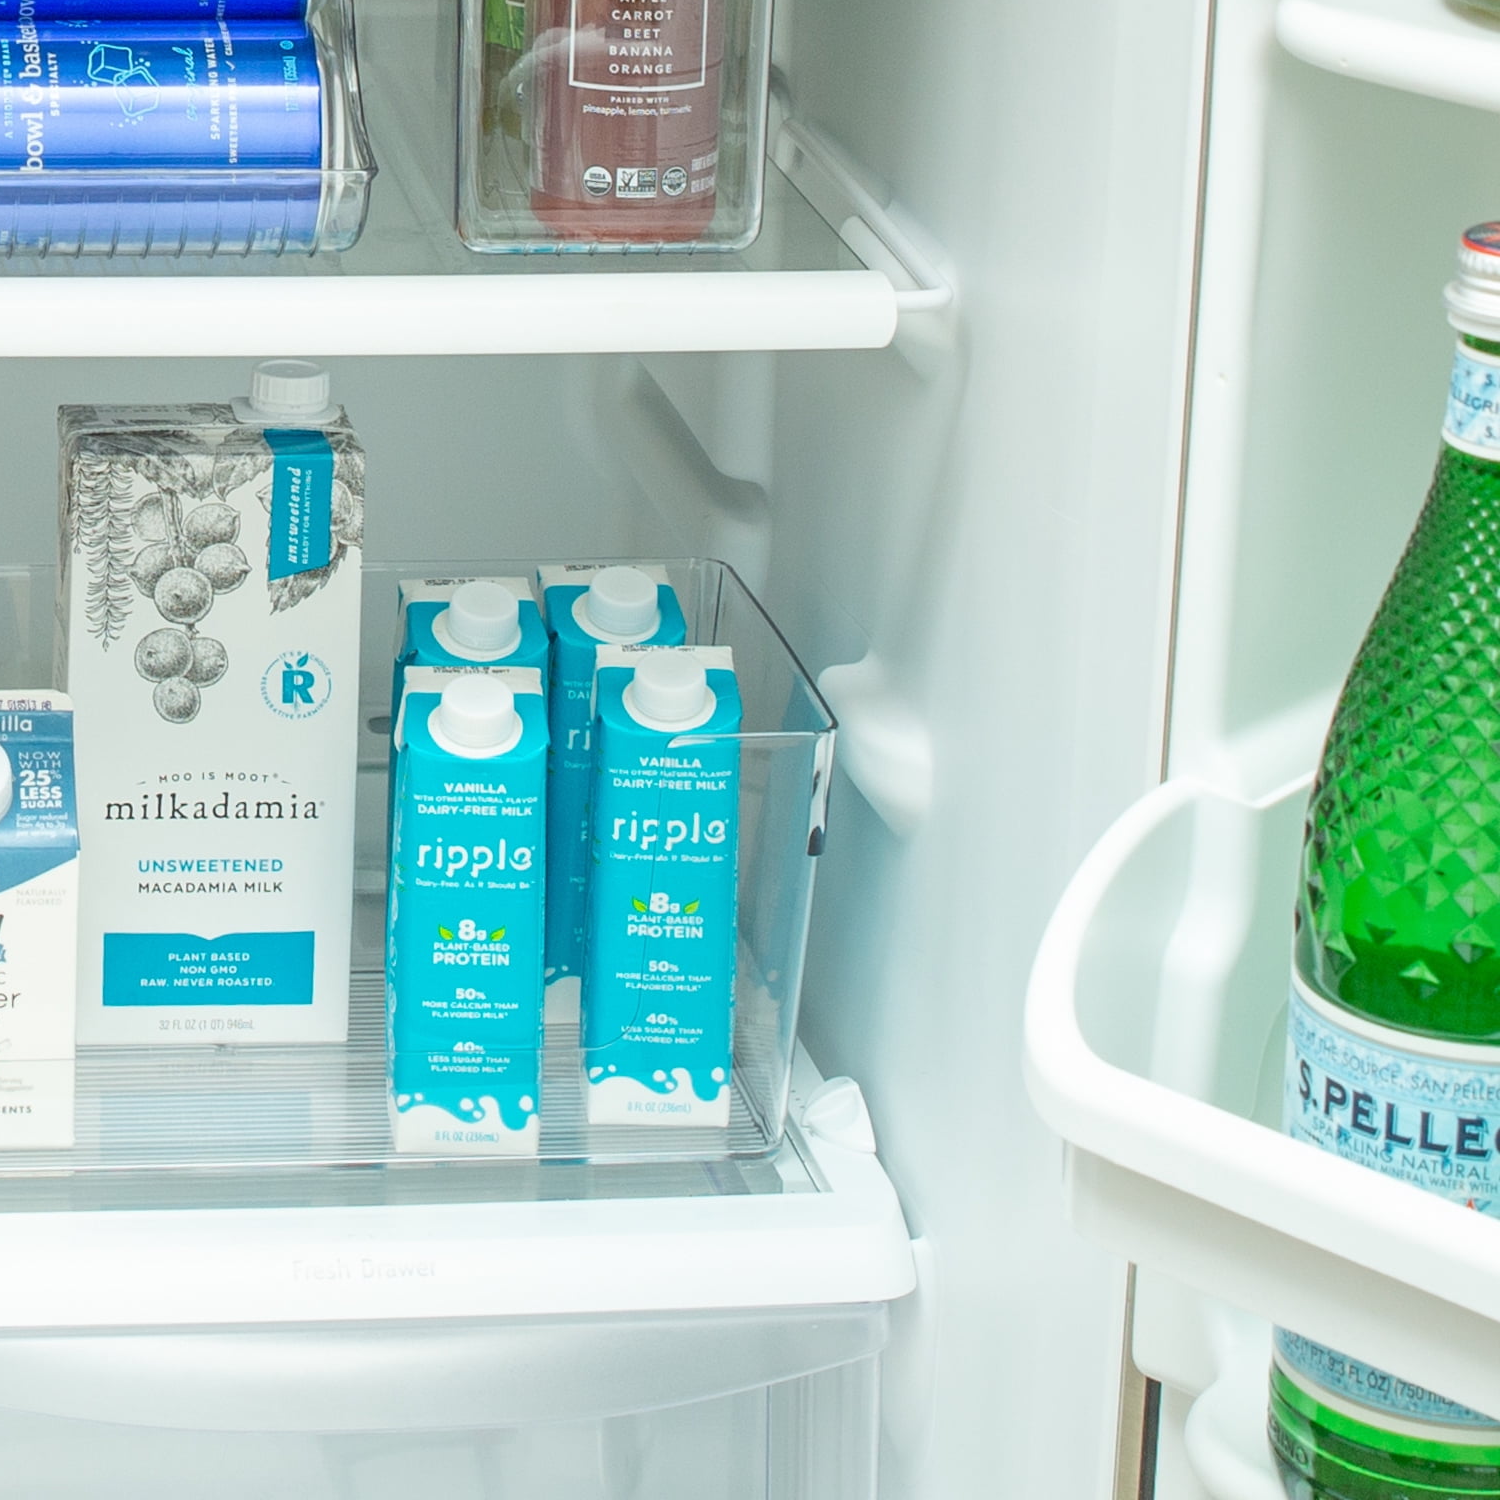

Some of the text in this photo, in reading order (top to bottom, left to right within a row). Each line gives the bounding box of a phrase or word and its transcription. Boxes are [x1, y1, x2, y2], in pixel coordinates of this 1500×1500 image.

[611, 9, 674, 21] CARROT
[623, 28, 661, 39] BEET
[608, 45, 674, 57] BANANA
[608, 63, 673, 75] ORANGE
[22, 83, 44, 106] &
[610, 96, 670, 104] PAIRED WITH
[20, 111, 44, 172] bowl
[287, 466, 301, 564] unsweetened
[18, 752, 61, 760] NOW
[18, 760, 61, 769] WITH
[639, 757, 702, 769] VANILLA
[19, 770, 62, 787] 25%
[159, 772, 269, 784] MOO IS MOOT
[612, 778, 727, 791] DAIRY-FREE MILK
[19, 787, 62, 800] LESS
[444, 783, 507, 794] VANILLA
[20, 800, 62, 809] SUGAR
[104, 792, 320, 820] milkadamia
[417, 804, 533, 817] DAIRY-FREE MILK
[611, 810, 729, 851] ripple
[416, 837, 535, 878] ripple
[138, 859, 283, 873] UNSWEETENED
[138, 882, 283, 893] MACADAMIA MILK
[649, 892, 681, 914] 8g
[627, 914, 704, 925] PLANT-BASED
[458, 919, 487, 941] 8g
[627, 924, 703, 938] PROTEIN
[433, 942, 510, 952] PLANT-BASED
[168, 953, 250, 962] PLANT BASED
[432, 952, 510, 966] PROTEIN
[180, 965, 238, 974] NON GMO
[140, 978, 213, 987] RAW. NEVER
[455, 988, 486, 1001] 50%
[453, 1041, 486, 1055] 40%
[1299, 1059, 1500, 1160] S.PELLE
[1402, 1154, 1490, 1181] NATURAL
[292, 1258, 436, 1281] Fresh Drawer
